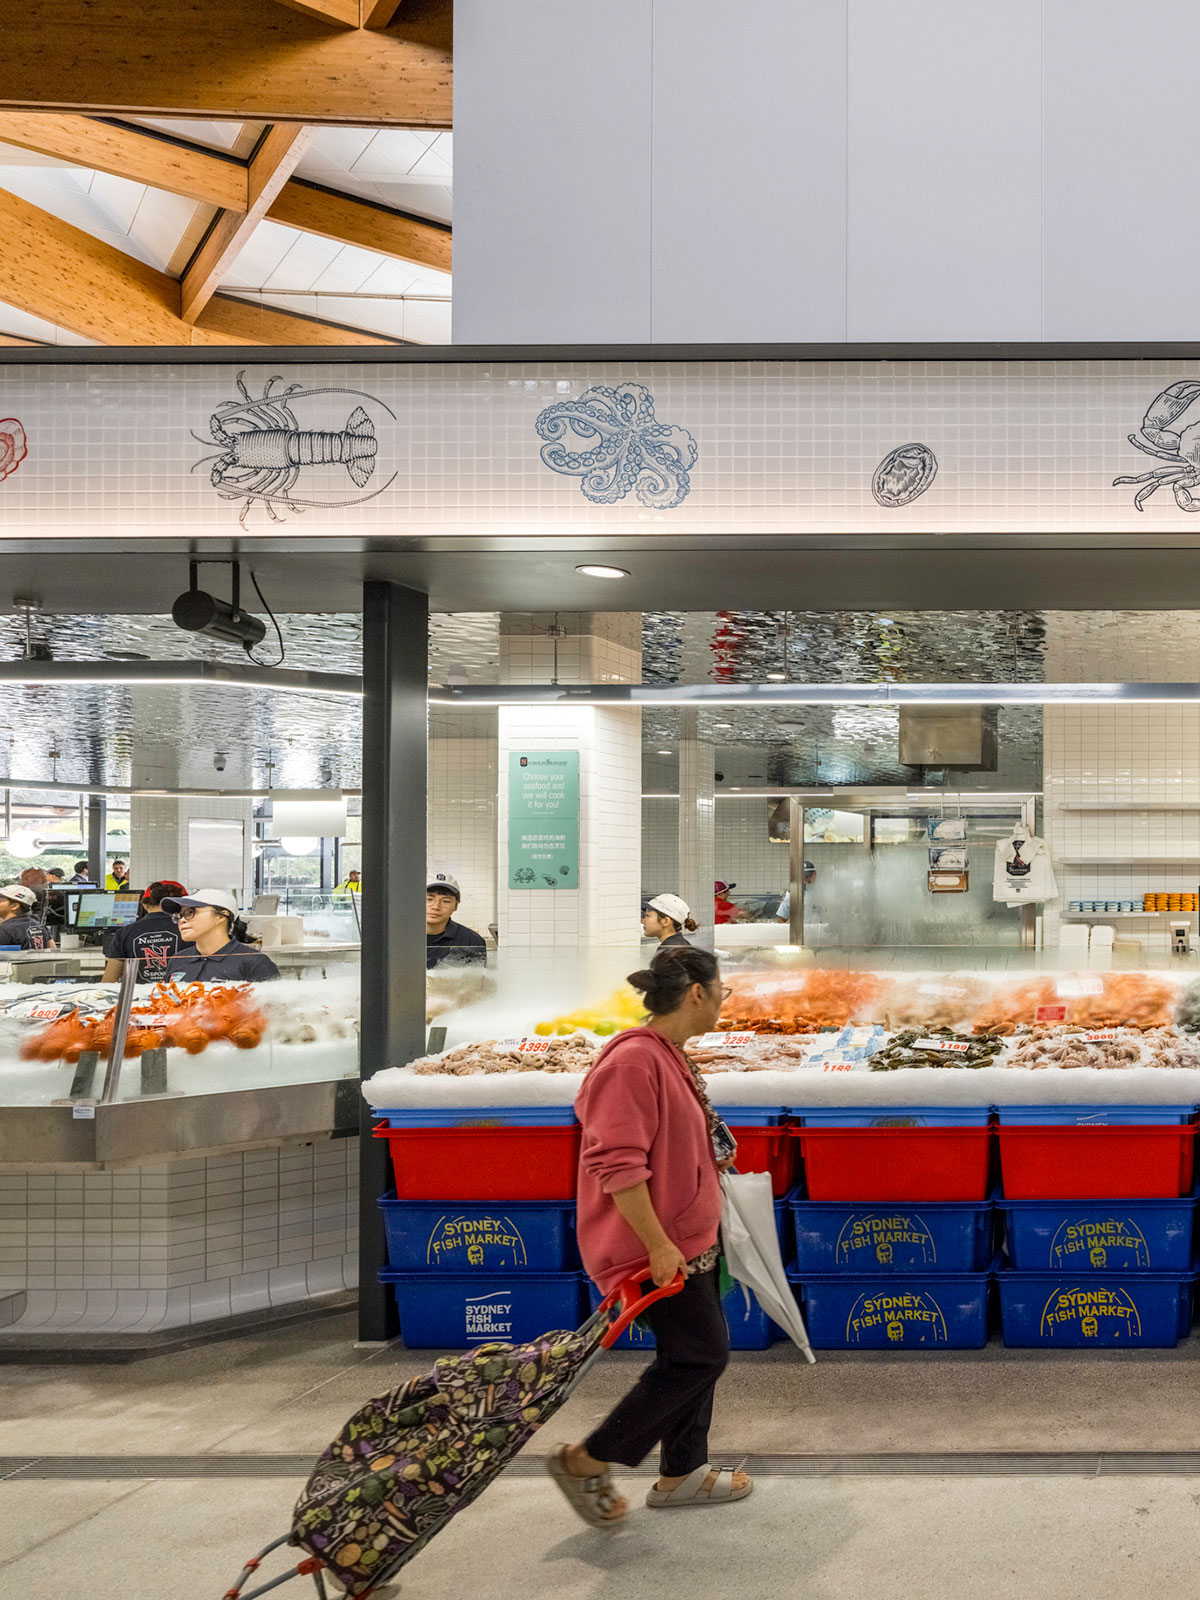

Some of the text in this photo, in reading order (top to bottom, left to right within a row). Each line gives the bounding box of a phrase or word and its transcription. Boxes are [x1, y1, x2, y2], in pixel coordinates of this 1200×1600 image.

[523, 772, 565, 782] Choose your
[523, 782, 565, 790] seafood and
[535, 791, 547, 799] will
[549, 791, 565, 799] cook
[534, 800, 543, 808] for
[545, 800, 560, 810] you!
[518, 1042, 549, 1052] 4399
[723, 1036, 751, 1044] 3299
[444, 1219, 501, 1236] SYDNEY
[853, 1217, 911, 1235] SYDNEY
[1066, 1221, 1125, 1239] SYDNEY
[432, 1233, 518, 1254] FISH MARKET
[841, 1231, 928, 1253] FISH MARKET
[1055, 1236, 1142, 1258] FISH MARKET
[863, 1295, 922, 1313] SYDNEY
[1058, 1291, 1116, 1308] SYDNEY
[465, 1304, 512, 1315] SYDNEY
[1046, 1305, 1133, 1327] FISH MARKET
[466, 1314, 492, 1324] FISH
[466, 1322, 512, 1333] MARKET
[852, 1309, 938, 1332] FISH MARKET
